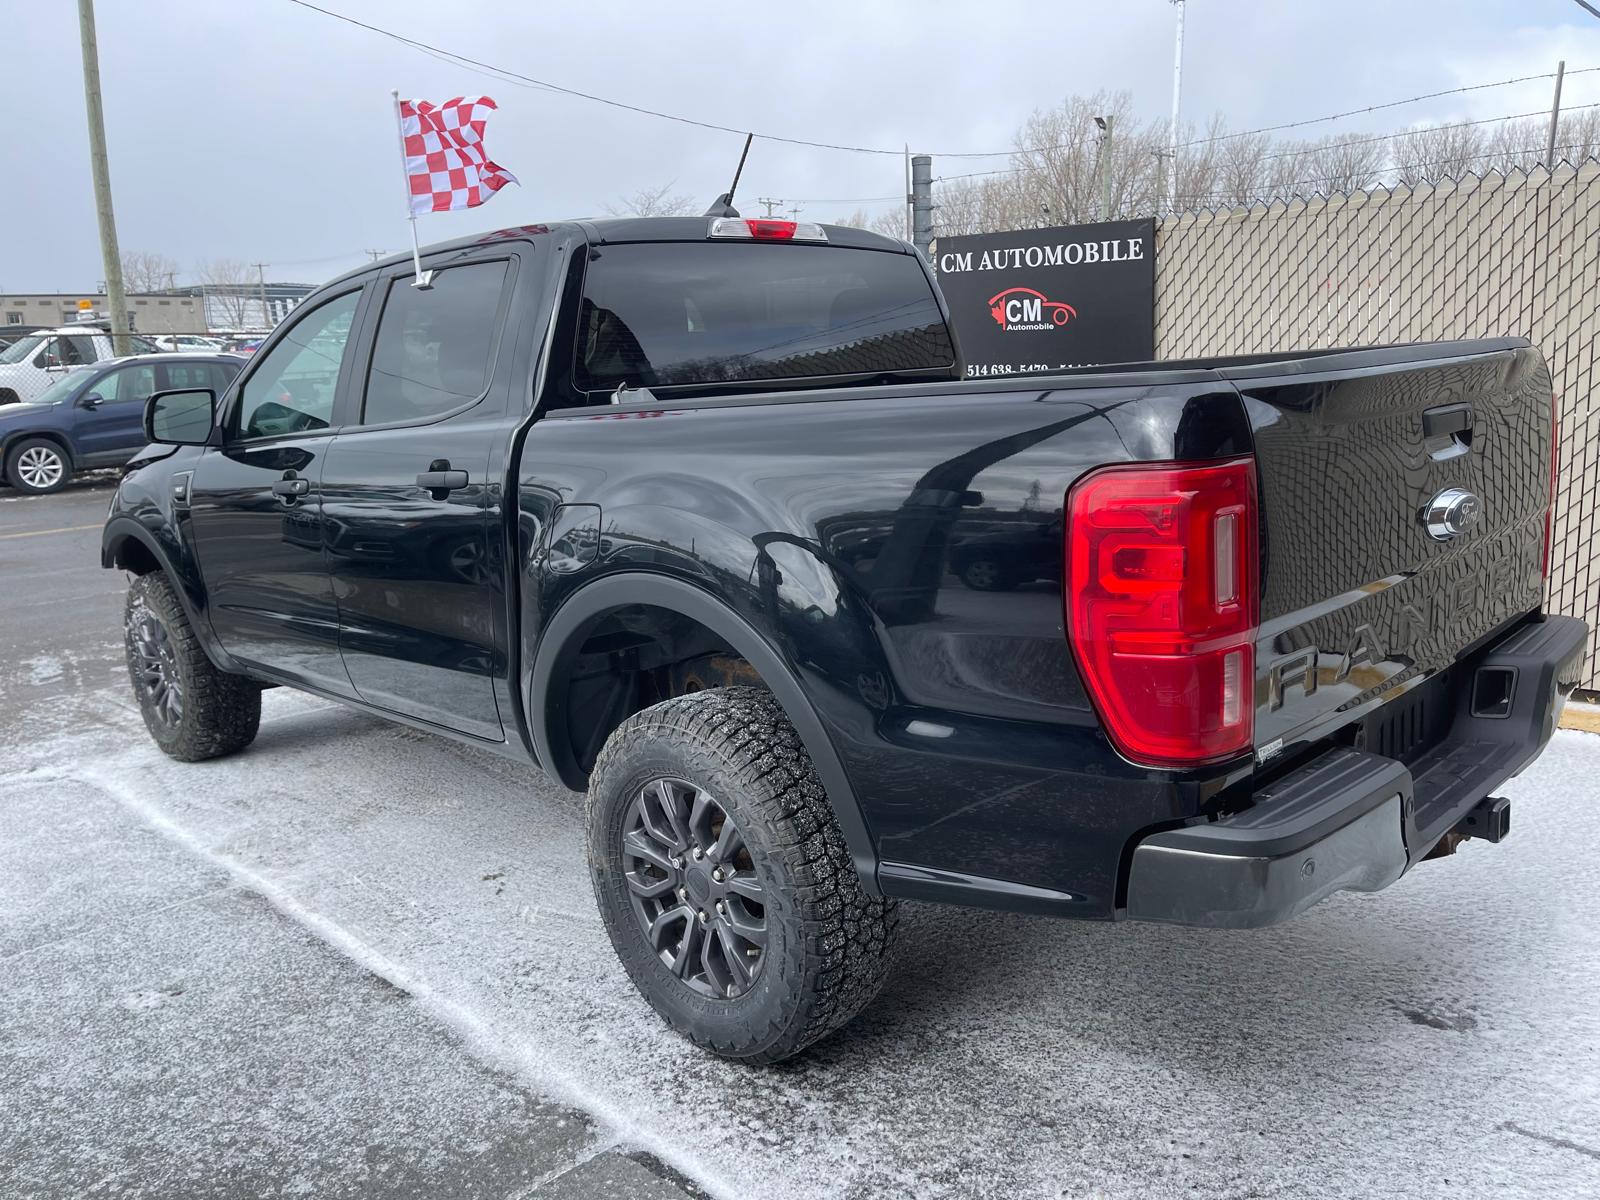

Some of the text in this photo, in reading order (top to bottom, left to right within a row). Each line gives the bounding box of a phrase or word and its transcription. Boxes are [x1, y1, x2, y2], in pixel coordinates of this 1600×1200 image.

[940, 238, 1143, 273] CM AUTOMOBILE
[1005, 299, 1042, 322] CM
[1006, 323, 1054, 331] Automobile
[967, 364, 988, 377] 514
[1460, 501, 1478, 526] Ford
